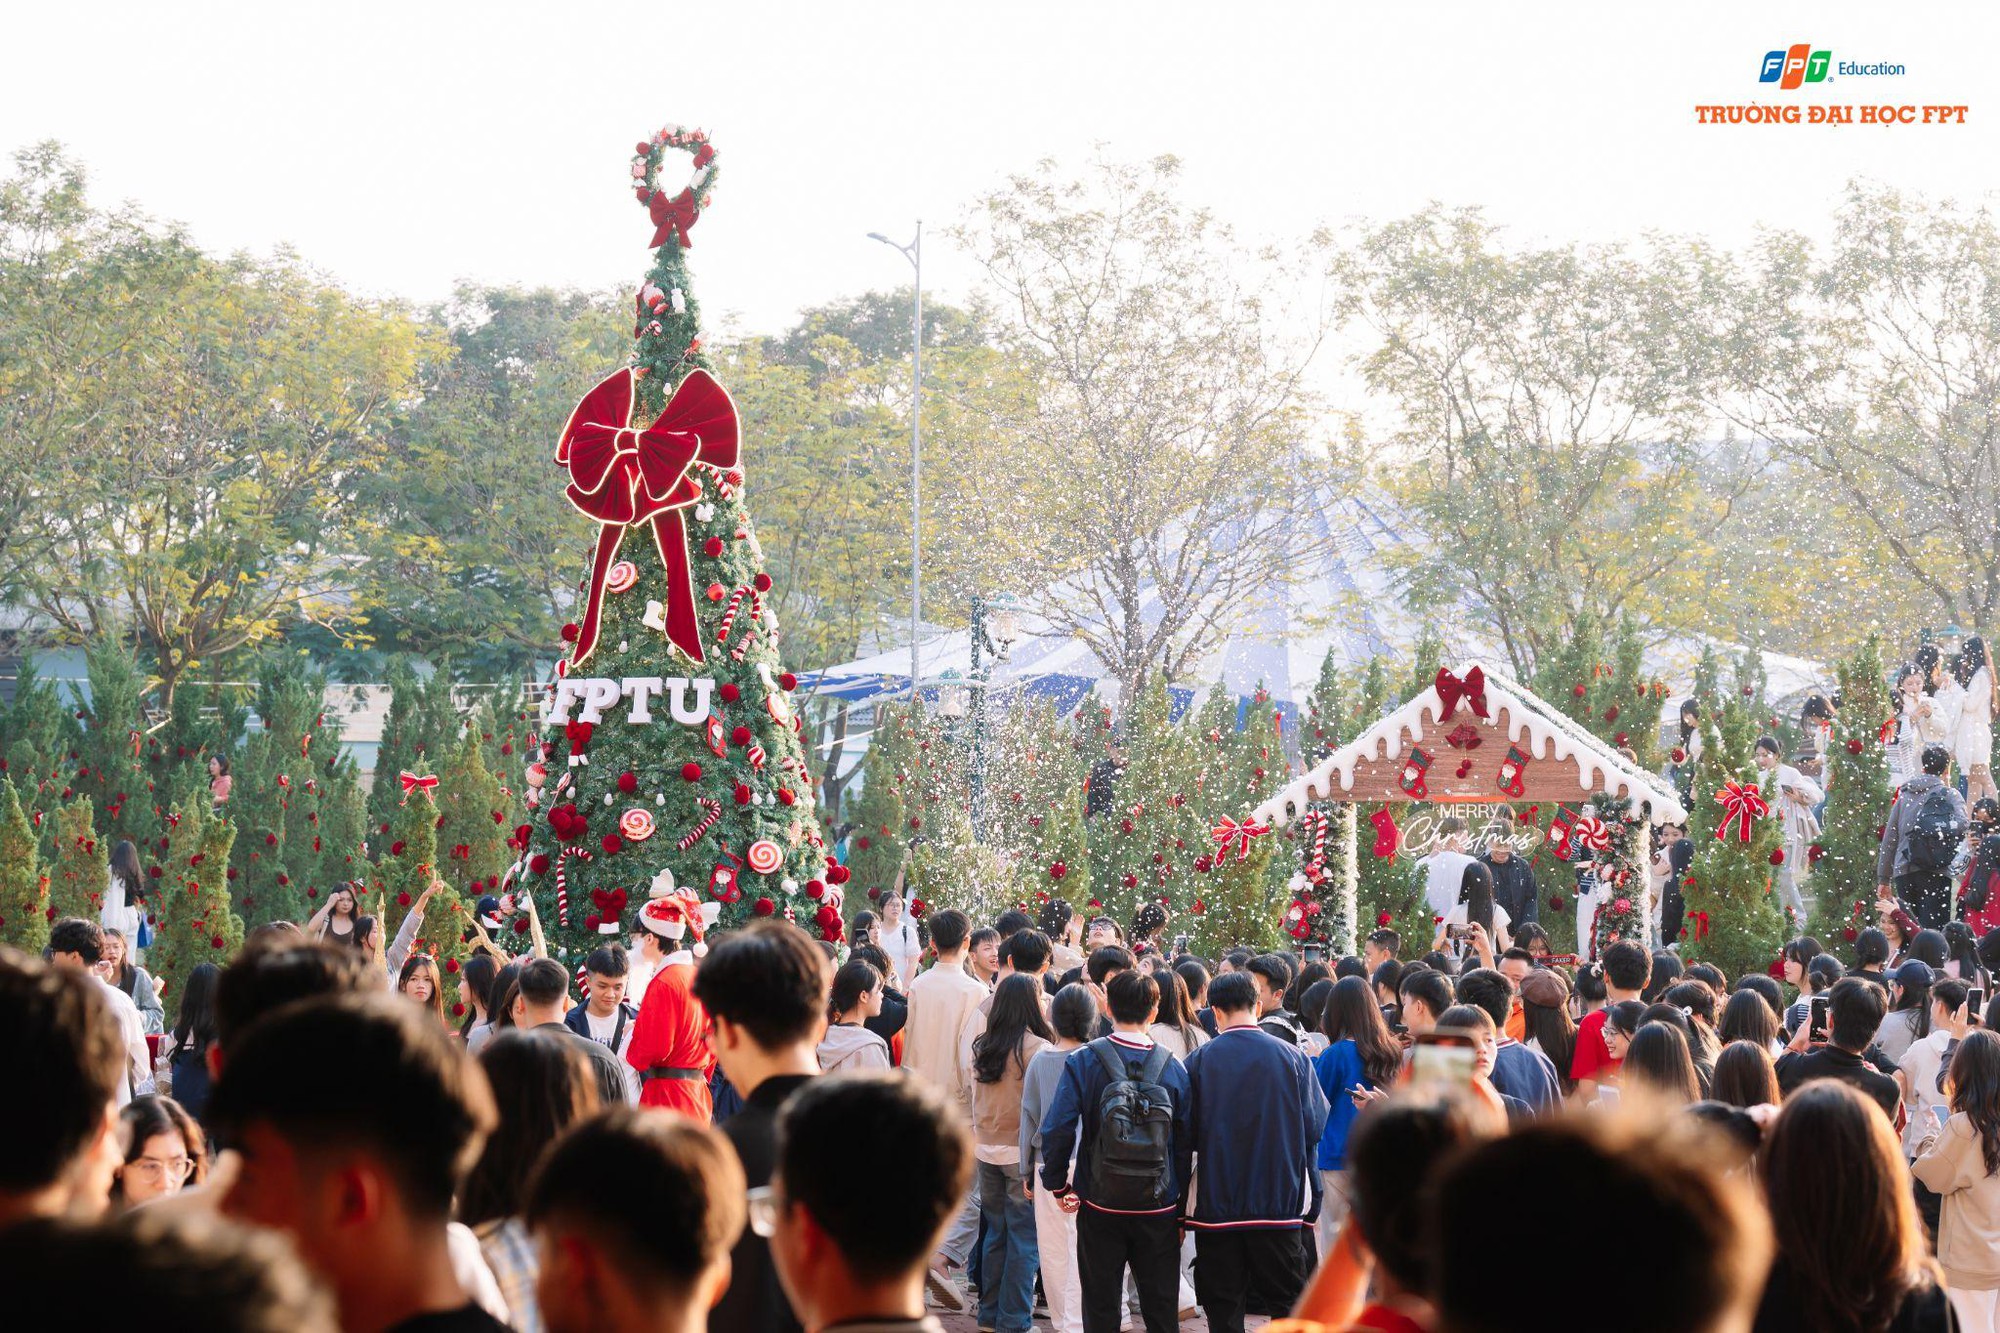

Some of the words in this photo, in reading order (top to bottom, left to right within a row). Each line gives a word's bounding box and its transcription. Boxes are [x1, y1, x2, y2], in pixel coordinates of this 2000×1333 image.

[548, 677, 716, 726] FPTU
[1439, 803, 1500, 819] MERRY
[1403, 816, 1538, 854] Christmas
